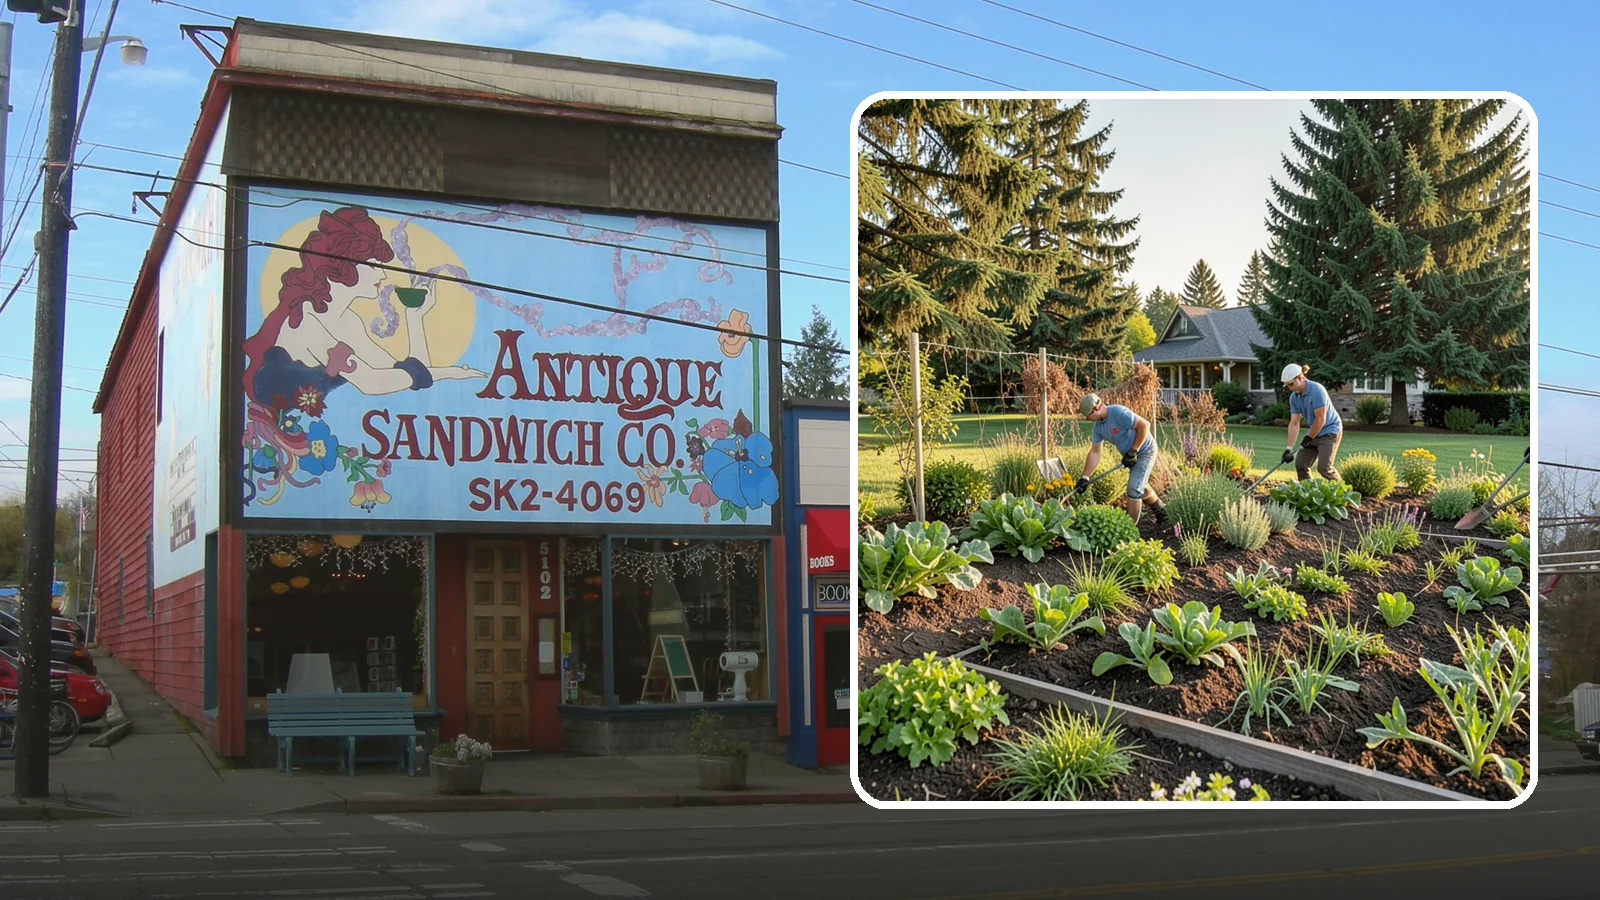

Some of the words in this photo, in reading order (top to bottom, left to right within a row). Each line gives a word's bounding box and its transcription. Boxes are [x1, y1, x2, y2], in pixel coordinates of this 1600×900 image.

[475, 329, 724, 420] ANTIQUE
[361, 408, 604, 467] SANDWICH
[617, 421, 685, 469] CO.
[467, 477, 646, 513] SK2-4069
[540, 541, 551, 600] 5102
[809, 555, 835, 569] BOOKS
